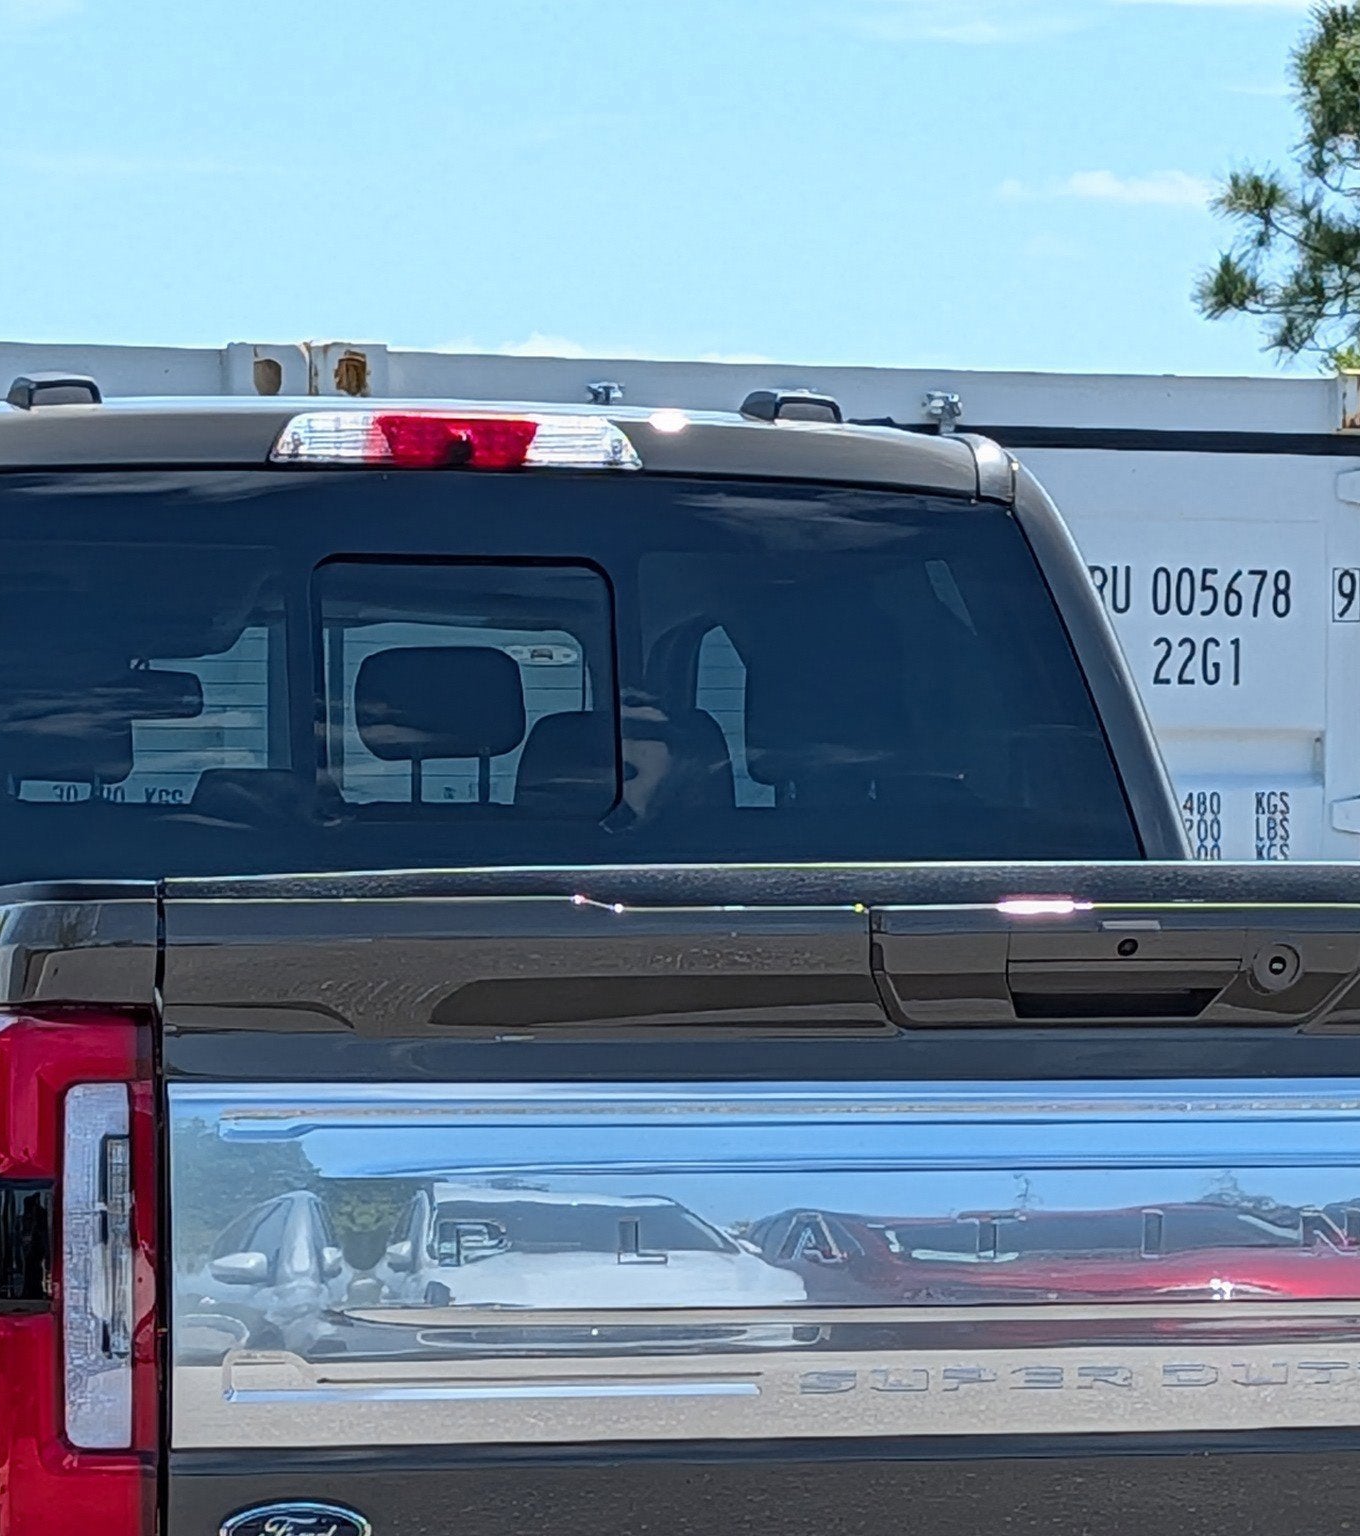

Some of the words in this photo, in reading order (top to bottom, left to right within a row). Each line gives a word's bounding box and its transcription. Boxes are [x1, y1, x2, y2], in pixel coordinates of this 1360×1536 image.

[1152, 566, 1292, 618] 005678
[1337, 569, 1357, 618] 9
[1152, 637, 1241, 686] 22G1
[1255, 791, 1291, 816] KGS
[1255, 816, 1291, 843] LBS
[799, 1365, 1133, 1394] SUPER
